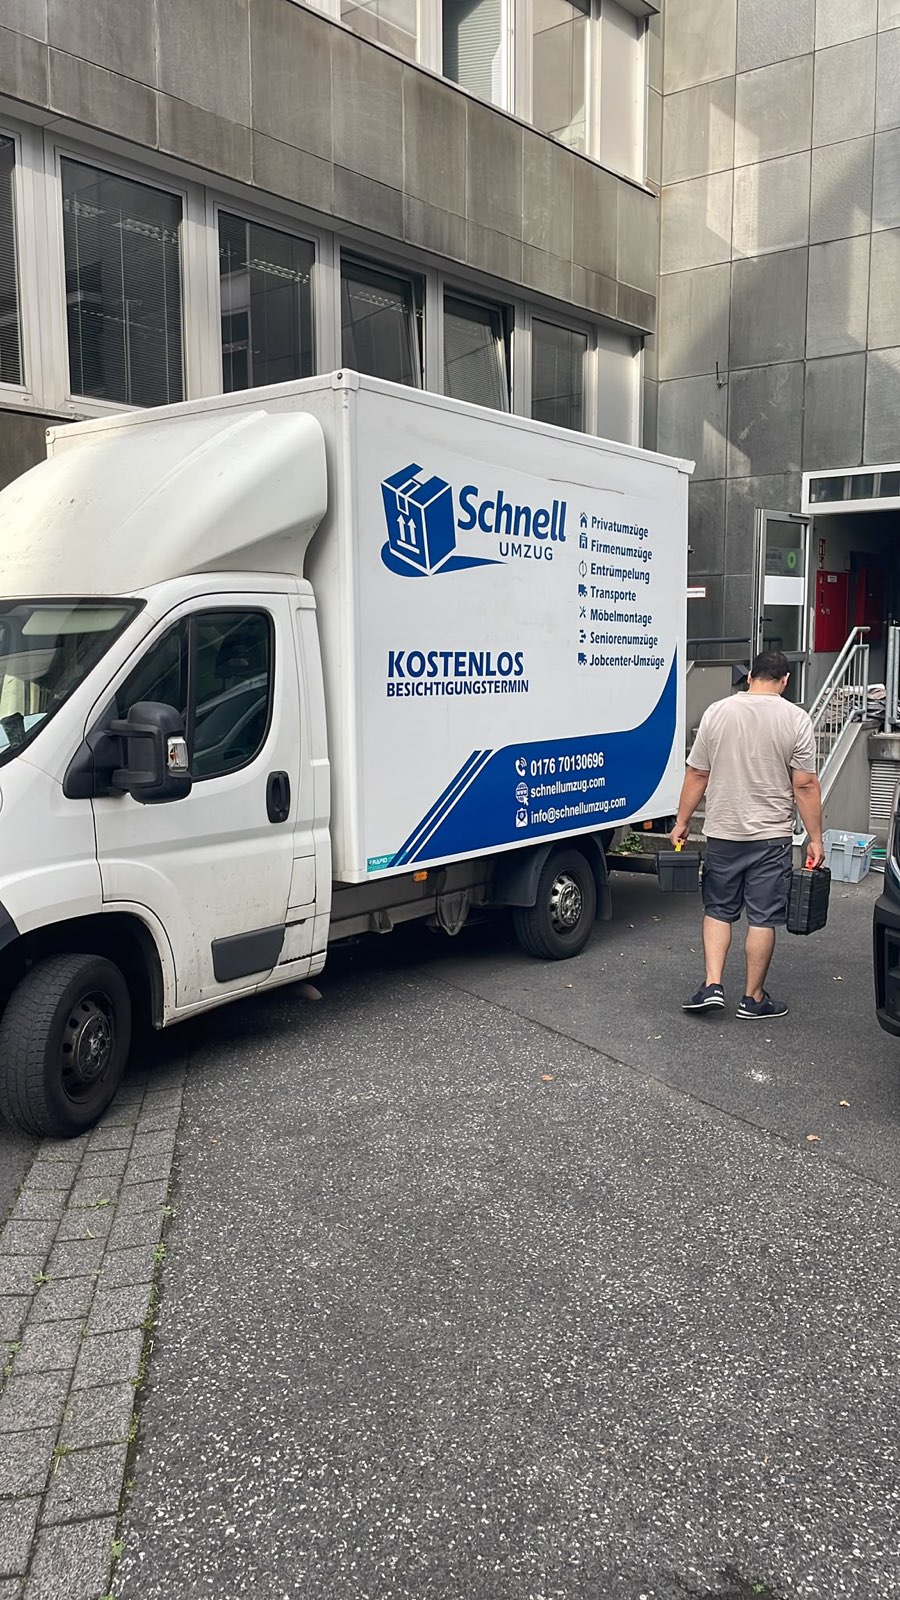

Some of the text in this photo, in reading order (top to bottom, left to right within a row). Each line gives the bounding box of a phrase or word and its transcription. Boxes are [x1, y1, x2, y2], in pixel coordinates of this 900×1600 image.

[457, 485, 567, 542] Schnell
[591, 516, 649, 540] Privatumzüge
[499, 542, 553, 561] UMZUG
[591, 539, 653, 562] Firmenumzüge
[590, 563, 650, 584] Entrümpelung
[590, 586, 637, 603] Transporte
[590, 608, 652, 627] Möbelmontage
[590, 631, 658, 648] Seniorenumzüge
[387, 651, 524, 678] KOSTENLOS
[589, 653, 665, 670] Jobcenter-Umzüge
[386, 680, 529, 697] BESICHTIGUNGSTERMIN
[530, 752, 604, 777] 0176 70130696
[530, 776, 606, 798] schnellumzug.com
[530, 796, 627, 824] info@schnellumzug.com
